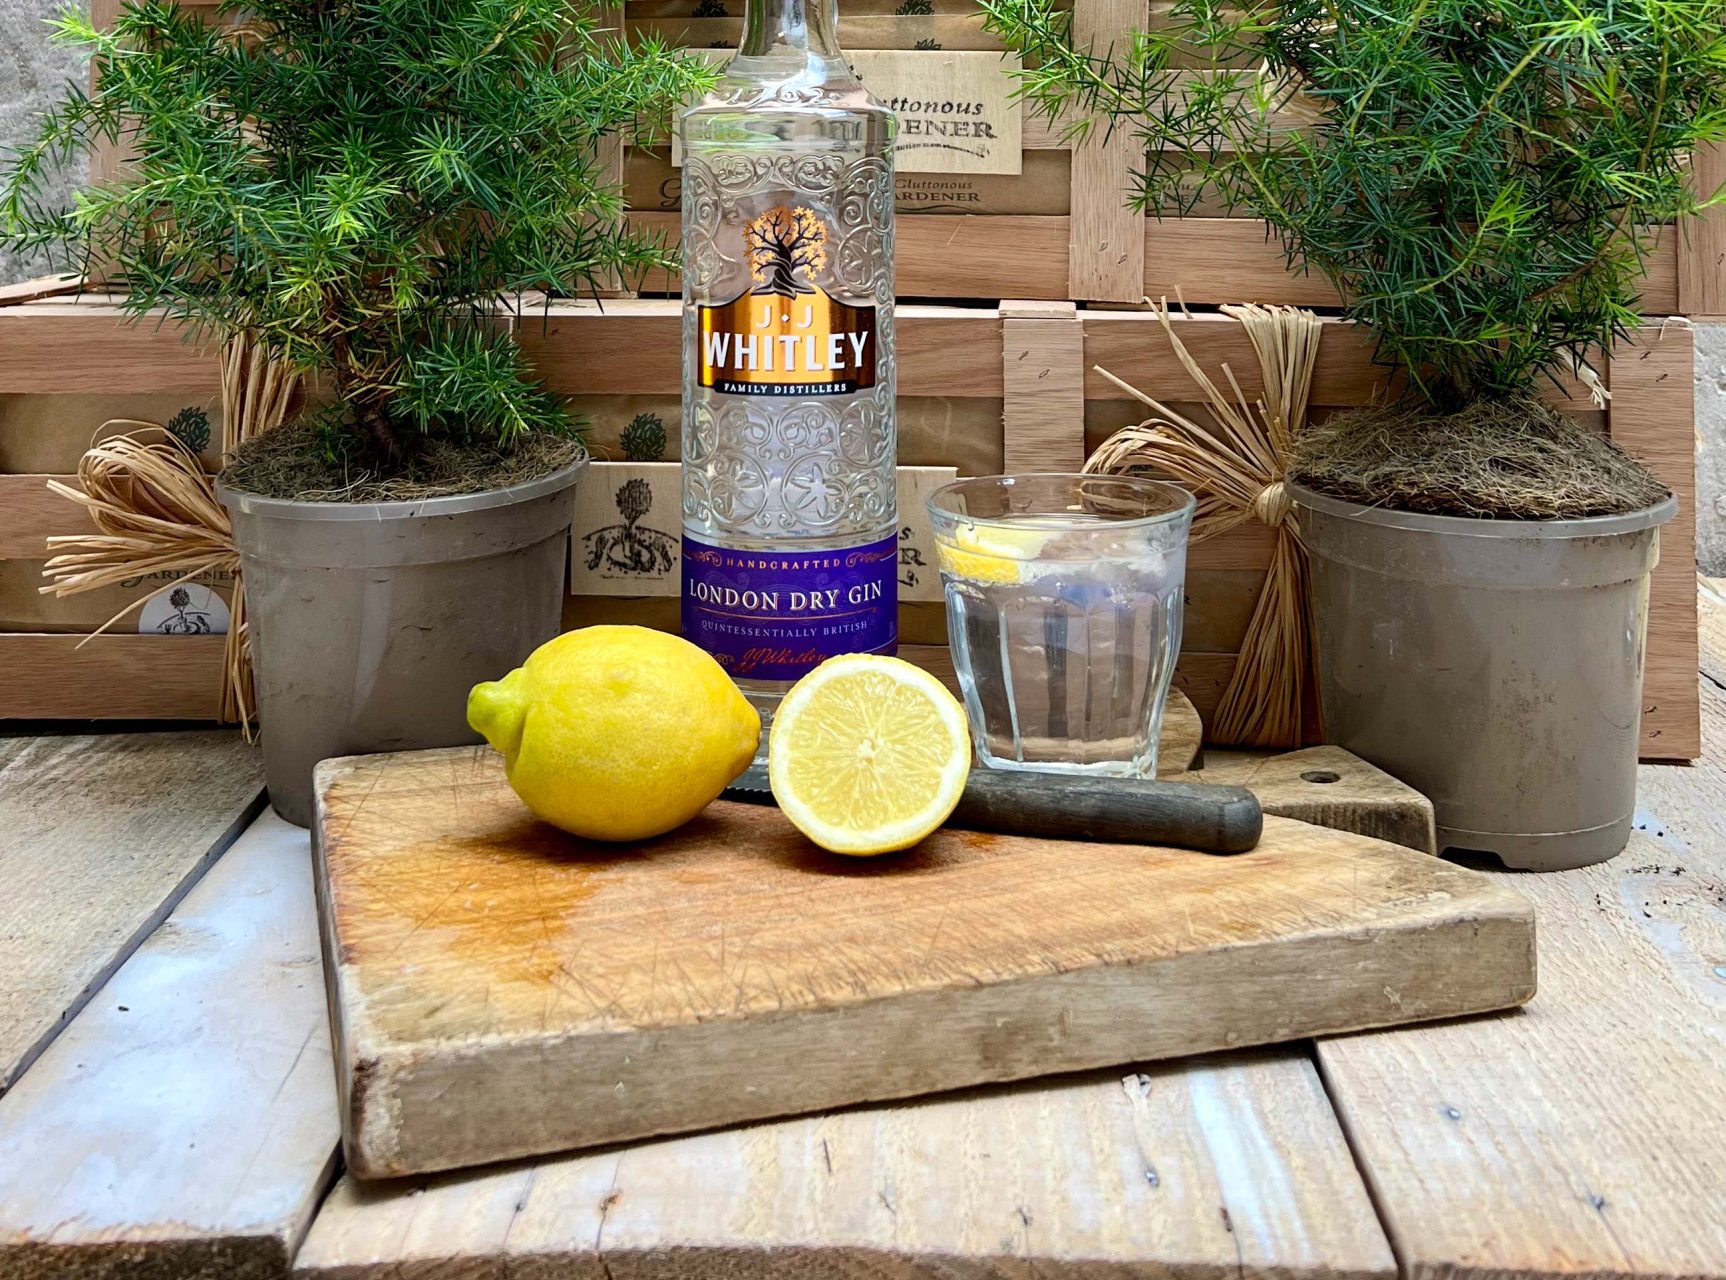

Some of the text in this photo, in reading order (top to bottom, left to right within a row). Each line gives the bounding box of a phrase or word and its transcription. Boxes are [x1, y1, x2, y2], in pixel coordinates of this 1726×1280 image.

[883, 97, 984, 116] ttonous
[895, 119, 998, 139] ENER
[703, 330, 869, 372] WHITLEY
[724, 382, 847, 395] FAMILY DISTILLERS
[726, 557, 841, 571] HANDCRAFTED
[689, 578, 882, 611] LONDON DRY GIN
[701, 619, 818, 638] QUINTESSENTIALLY
[823, 620, 868, 636] BRITISH
